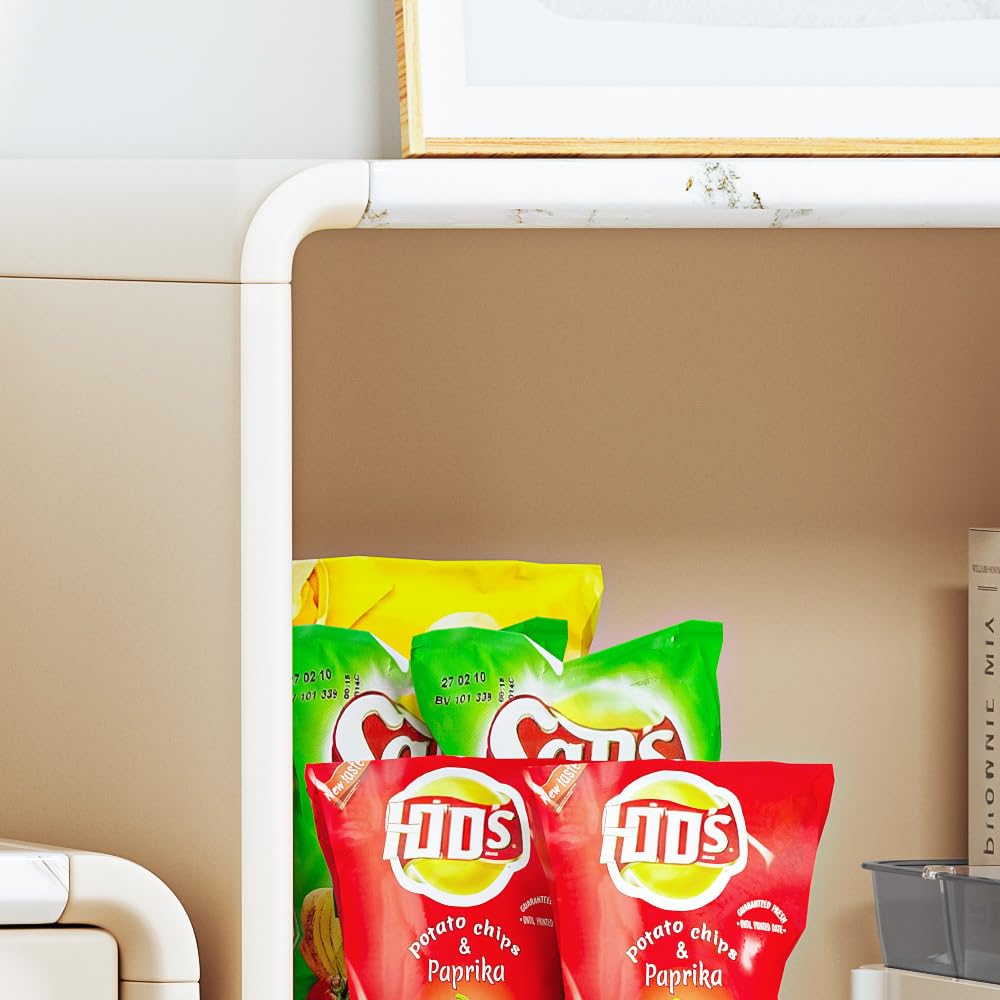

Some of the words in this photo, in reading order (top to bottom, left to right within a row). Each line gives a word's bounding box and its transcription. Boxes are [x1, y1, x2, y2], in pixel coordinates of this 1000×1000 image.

[303, 671, 316, 683] 02
[320, 668, 332, 680] 10
[441, 676, 454, 688] 27
[458, 674, 470, 686] 02
[474, 671, 486, 683] 10
[408, 915, 467, 960] potato
[474, 918, 521, 957] chips
[459, 937, 472, 955] &
[625, 919, 684, 963] potato
[690, 922, 738, 961] chips
[676, 941, 689, 960] &
[428, 956, 505, 990] Paprika
[645, 961, 723, 994] Paprika
